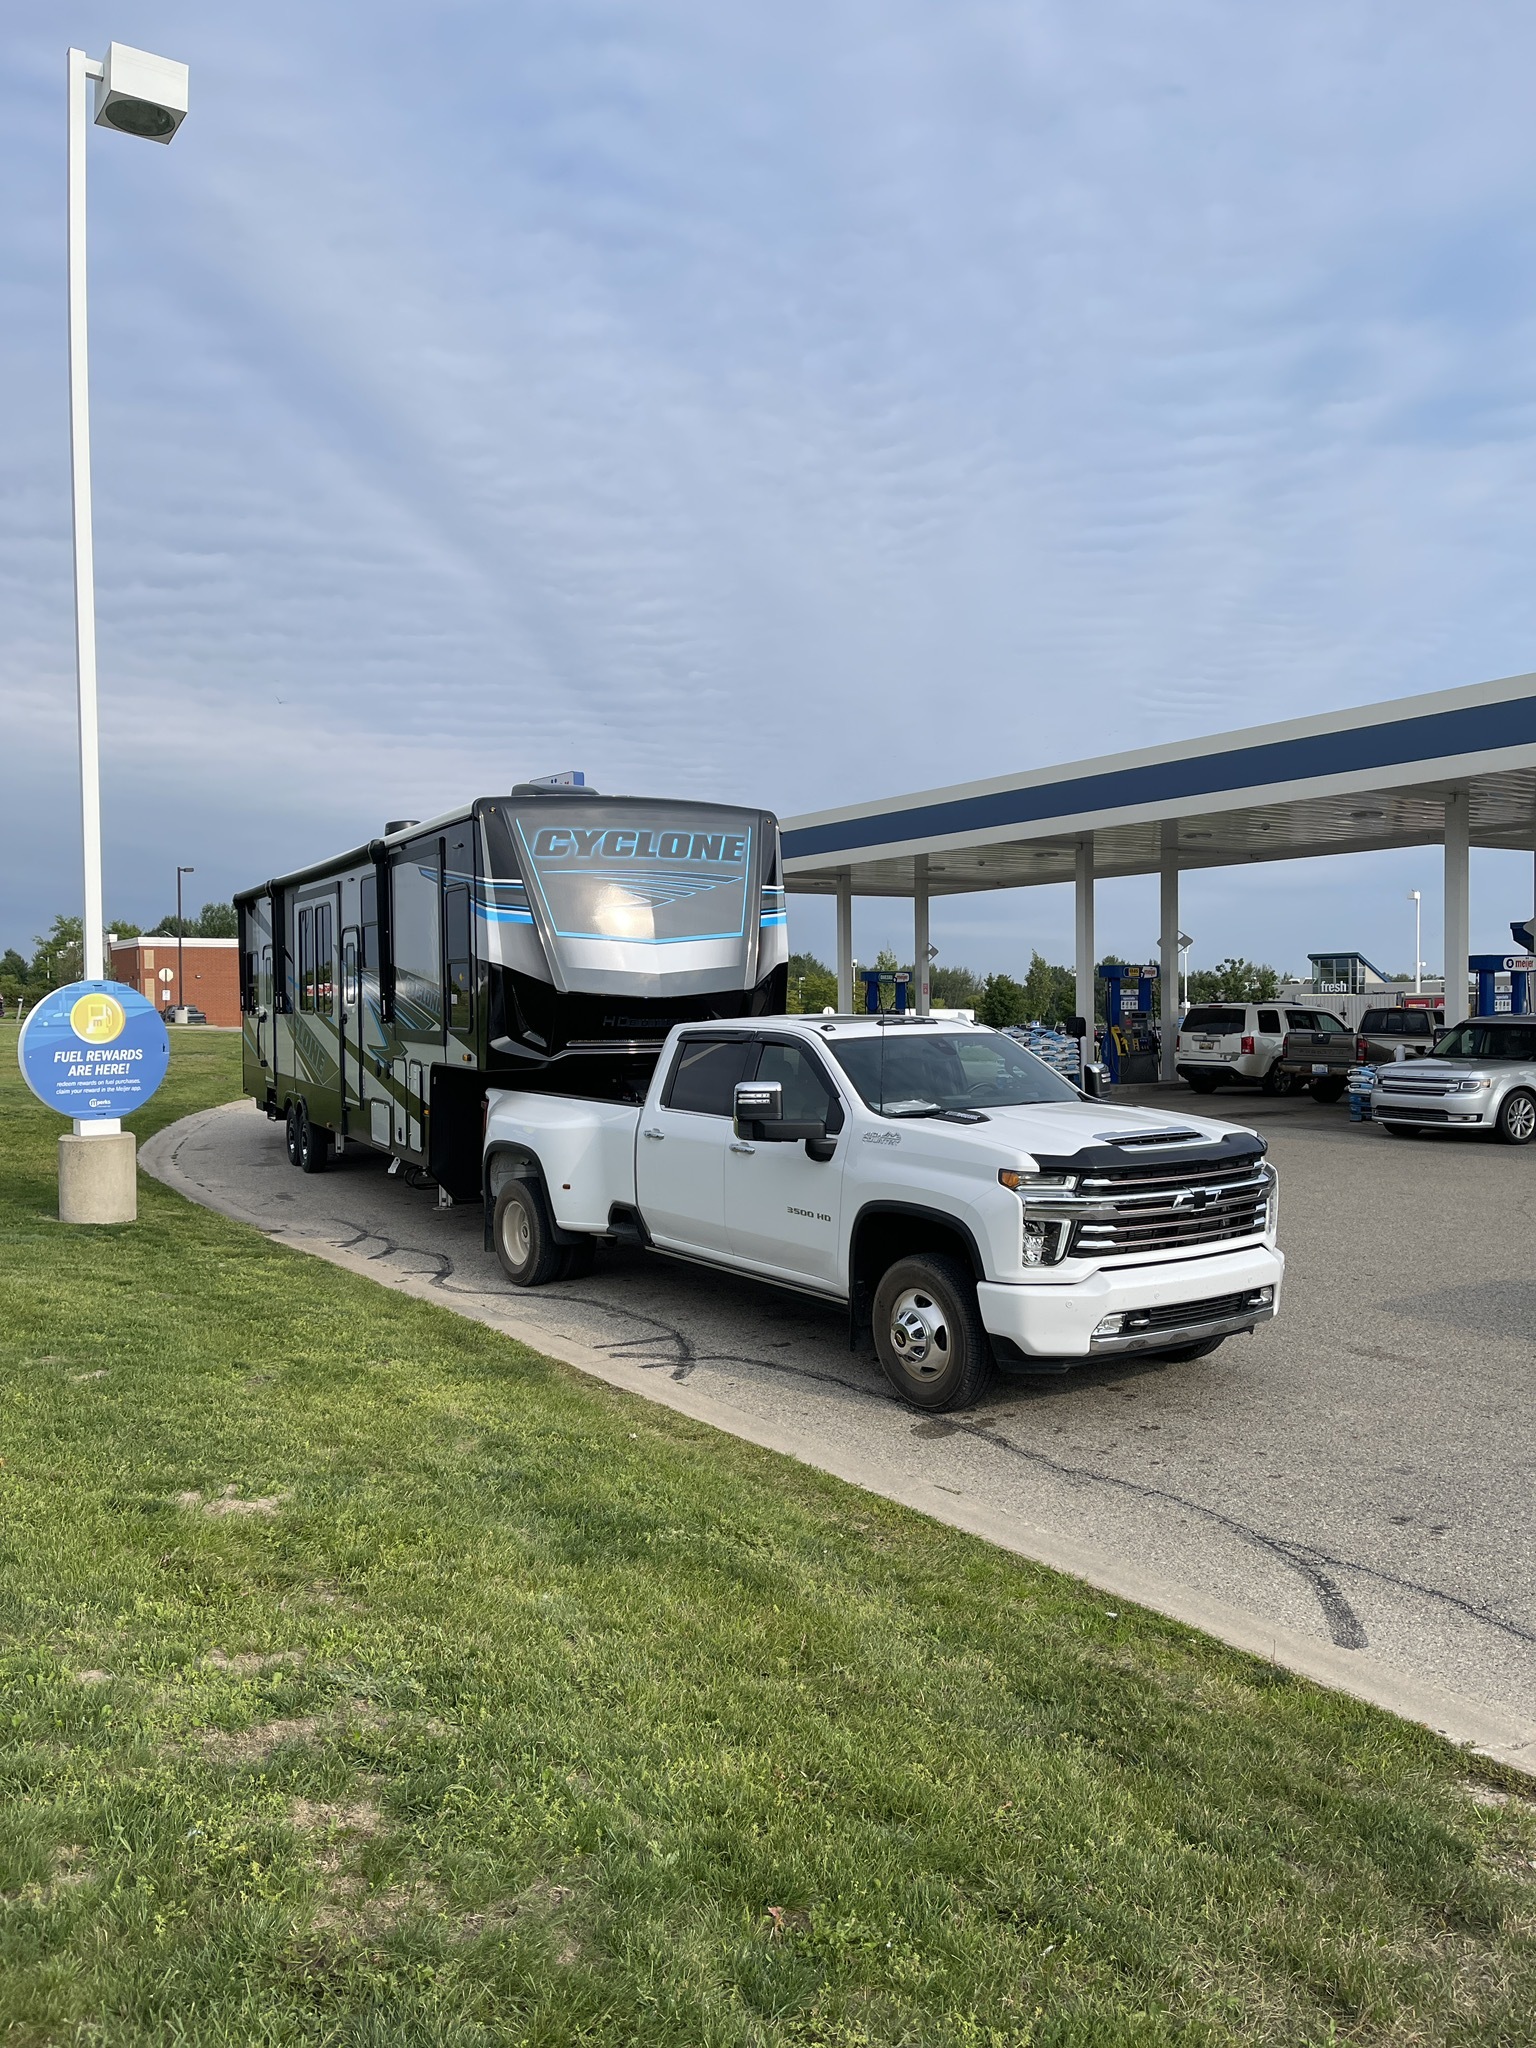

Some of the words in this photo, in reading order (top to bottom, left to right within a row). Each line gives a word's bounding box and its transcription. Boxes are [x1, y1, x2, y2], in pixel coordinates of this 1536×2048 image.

[533, 829, 746, 862] CYCLONE
[1515, 957, 1534, 970] meijer
[1321, 981, 1347, 992] fresh
[54, 1051, 83, 1063] FUEL
[86, 1048, 143, 1061] REWARDS
[68, 1064, 93, 1076] ARE
[95, 1063, 130, 1075] HERE!
[787, 1206, 814, 1218] 3500
[817, 1213, 831, 1222] HD
